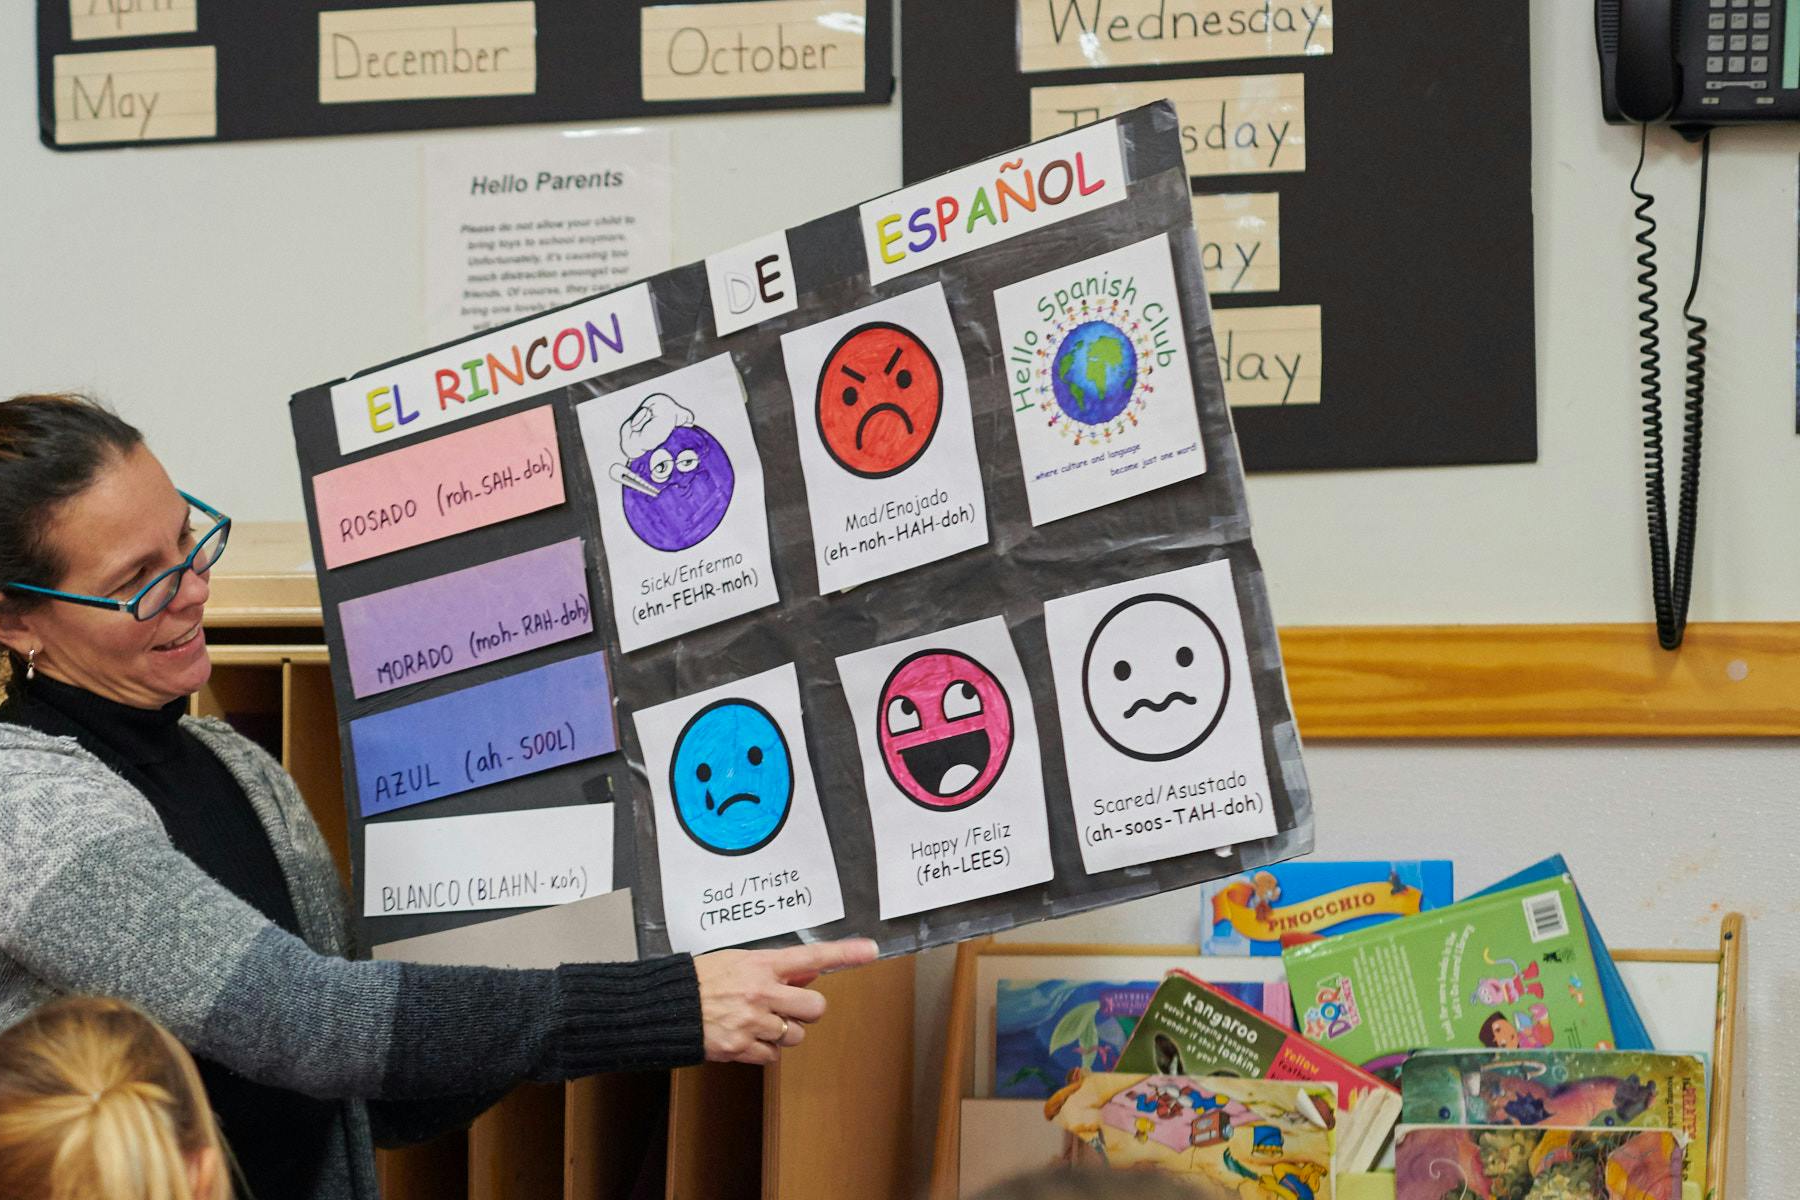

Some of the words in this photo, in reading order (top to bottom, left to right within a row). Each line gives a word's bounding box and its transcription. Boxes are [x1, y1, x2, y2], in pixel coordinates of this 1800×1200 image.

[1048, 0, 1323, 50] Wednesday
[330, 31, 511, 81] December
[667, 27, 838, 78] October
[73, 72, 160, 138] May
[470, 174, 528, 195] Hello
[536, 169, 623, 191] Parents
[461, 224, 496, 234] Please
[499, 222, 512, 231] do
[516, 221, 533, 230] not
[536, 219, 563, 229] allow
[568, 218, 591, 228] your
[594, 215, 621, 225] child
[625, 214, 636, 224] to
[468, 241, 495, 250] bring
[499, 239, 520, 249] toys
[525, 238, 535, 246] to
[538, 236, 575, 246] school
[565, 250, 608, 261] causing
[366, 385, 420, 433] EL
[434, 313, 624, 411] RINCON
[725, 254, 786, 314] DE
[876, 152, 1106, 264] ESPAÑOL
[468, 272, 496, 282] much
[501, 270, 557, 281] distraction
[1011, 331, 1038, 412] Hello
[1037, 271, 1138, 321] Spanish
[1143, 303, 1176, 367] Club
[1061, 460, 1089, 473] culture
[1091, 451, 1105, 464] and
[1107, 444, 1140, 458] language
[1111, 463, 1139, 476] become
[1142, 456, 1157, 469] just
[1160, 452, 1174, 460] one
[340, 499, 417, 541] ROSADO
[845, 488, 948, 532] Mad/Enojado
[824, 503, 975, 566] (eh-noh-HAH-doh)
[640, 553, 743, 595] Sick/Enfermo
[632, 568, 759, 625] (ehn-FEHR-moh)
[377, 645, 453, 684] MORADO
[375, 763, 440, 802] AZUL
[1093, 771, 1247, 816] Scared/Asustado
[1085, 791, 1265, 848] (ah-soos-TAH-doh)
[911, 836, 959, 861] Happy
[916, 848, 1011, 887] (feh-LEES)
[382, 880, 460, 912] BLANCO
[700, 886, 812, 931] (TREES-teh)
[702, 882, 734, 904] Sad
[1268, 892, 1375, 932] PINOCCHIO
[1183, 991, 1258, 1044] Kangaroo
[1192, 1017, 1222, 1042] hopping
[1161, 1015, 1189, 1036] wonder
[1218, 1044, 1260, 1078] looking
[1196, 1051, 1218, 1064] you?
[1284, 1048, 1320, 1074] Yellow
